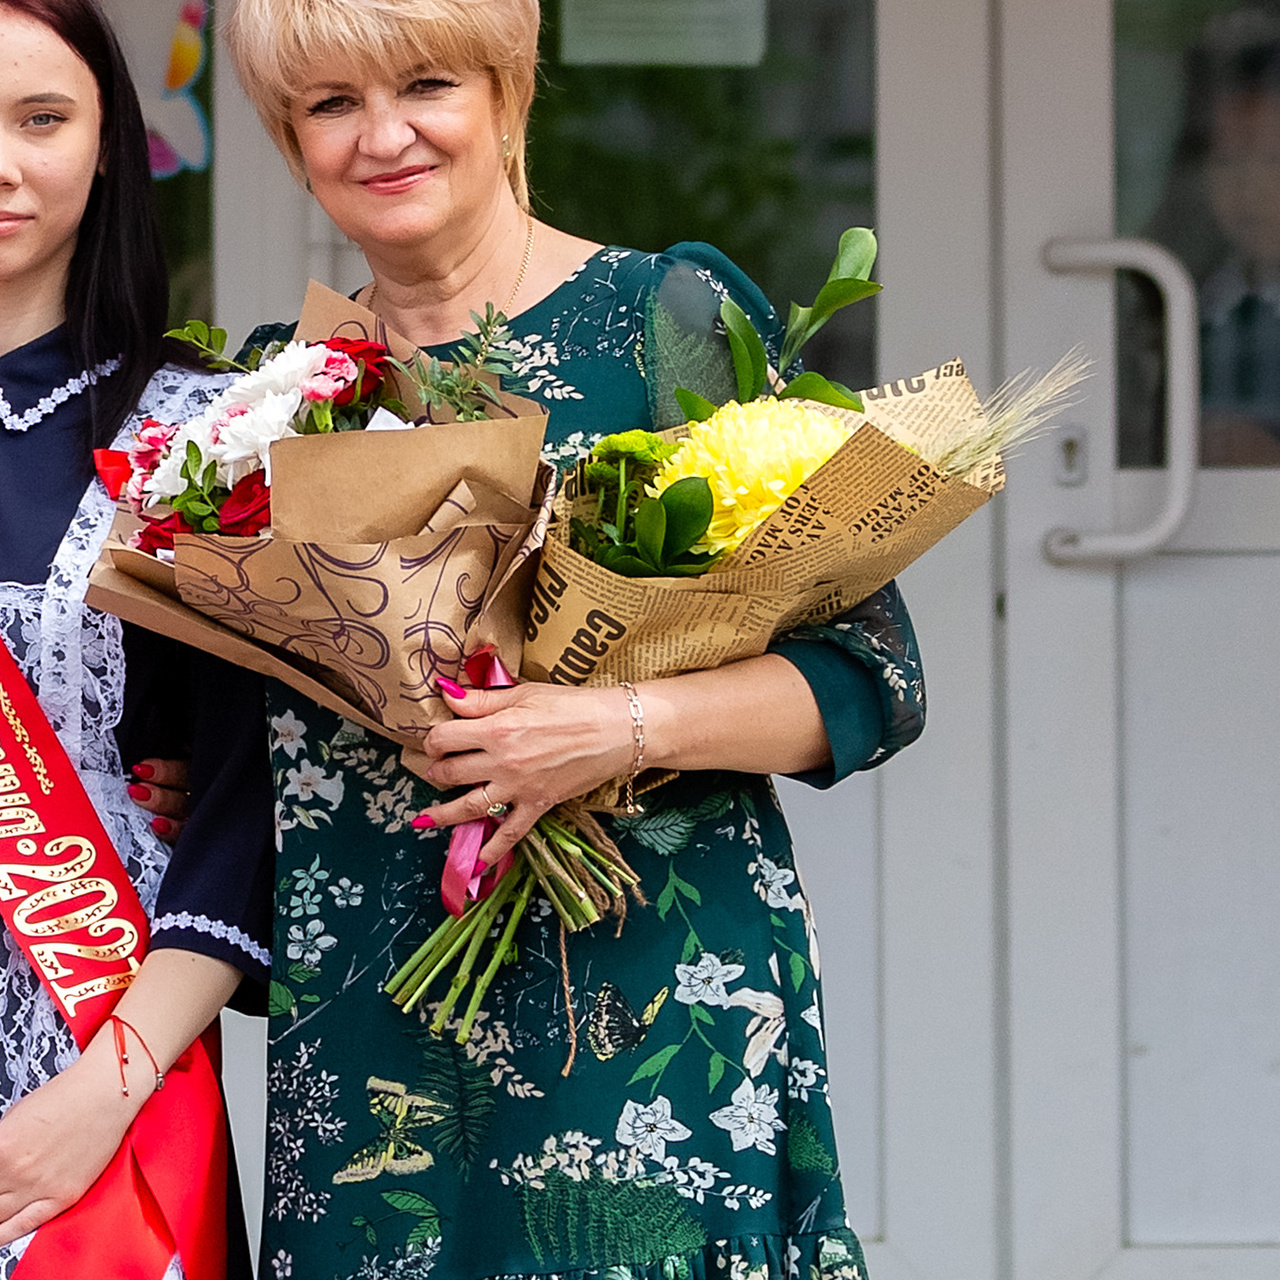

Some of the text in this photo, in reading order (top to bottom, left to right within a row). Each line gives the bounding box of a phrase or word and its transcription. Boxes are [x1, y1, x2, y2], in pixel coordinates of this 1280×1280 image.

[746, 496, 801, 565] OF MAG
[849, 465, 930, 537] OF MAGIC
[871, 502, 903, 533] AND
